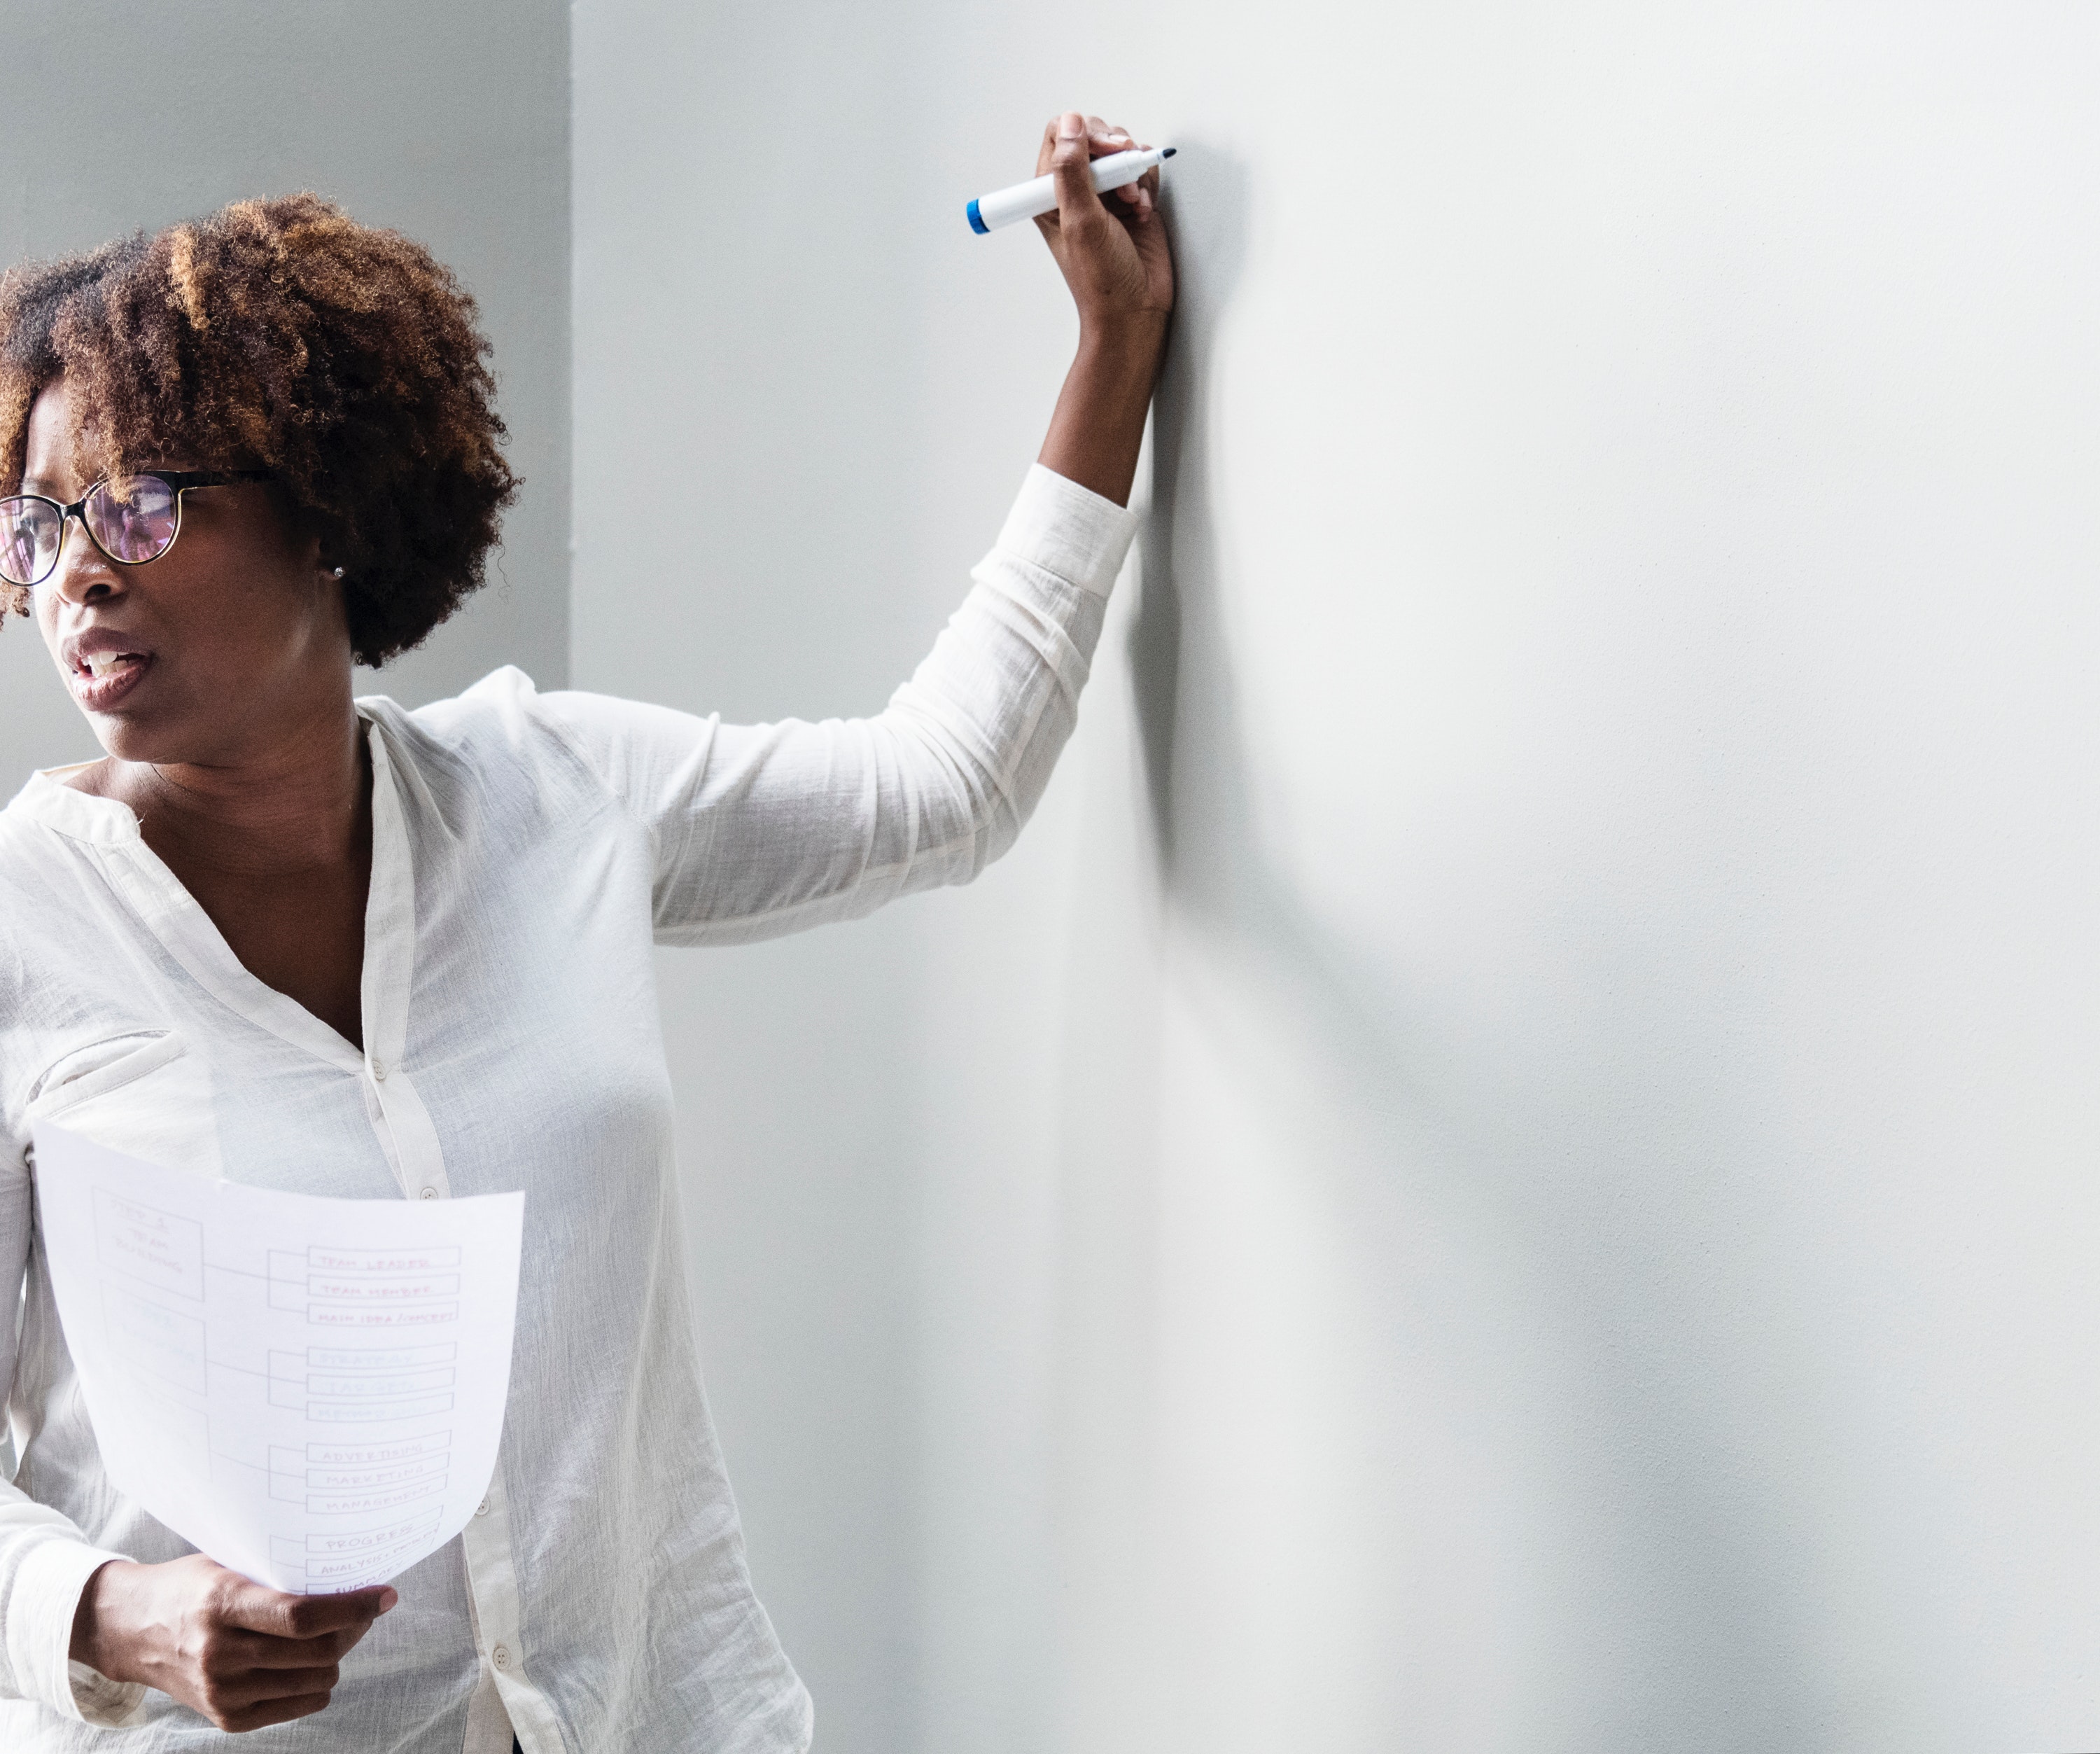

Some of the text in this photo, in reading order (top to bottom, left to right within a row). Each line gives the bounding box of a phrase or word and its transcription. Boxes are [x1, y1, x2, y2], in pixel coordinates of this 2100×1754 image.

[318, 1255, 430, 1271] TEAM LEADER
[321, 1285, 432, 1297] TEAM MEMBER
[322, 1443, 424, 1461] ADVERTISING
[326, 1464, 424, 1484] MARKETING
[326, 1484, 432, 1511] MANAGEMENT
[325, 1523, 414, 1550] PROGRESS
